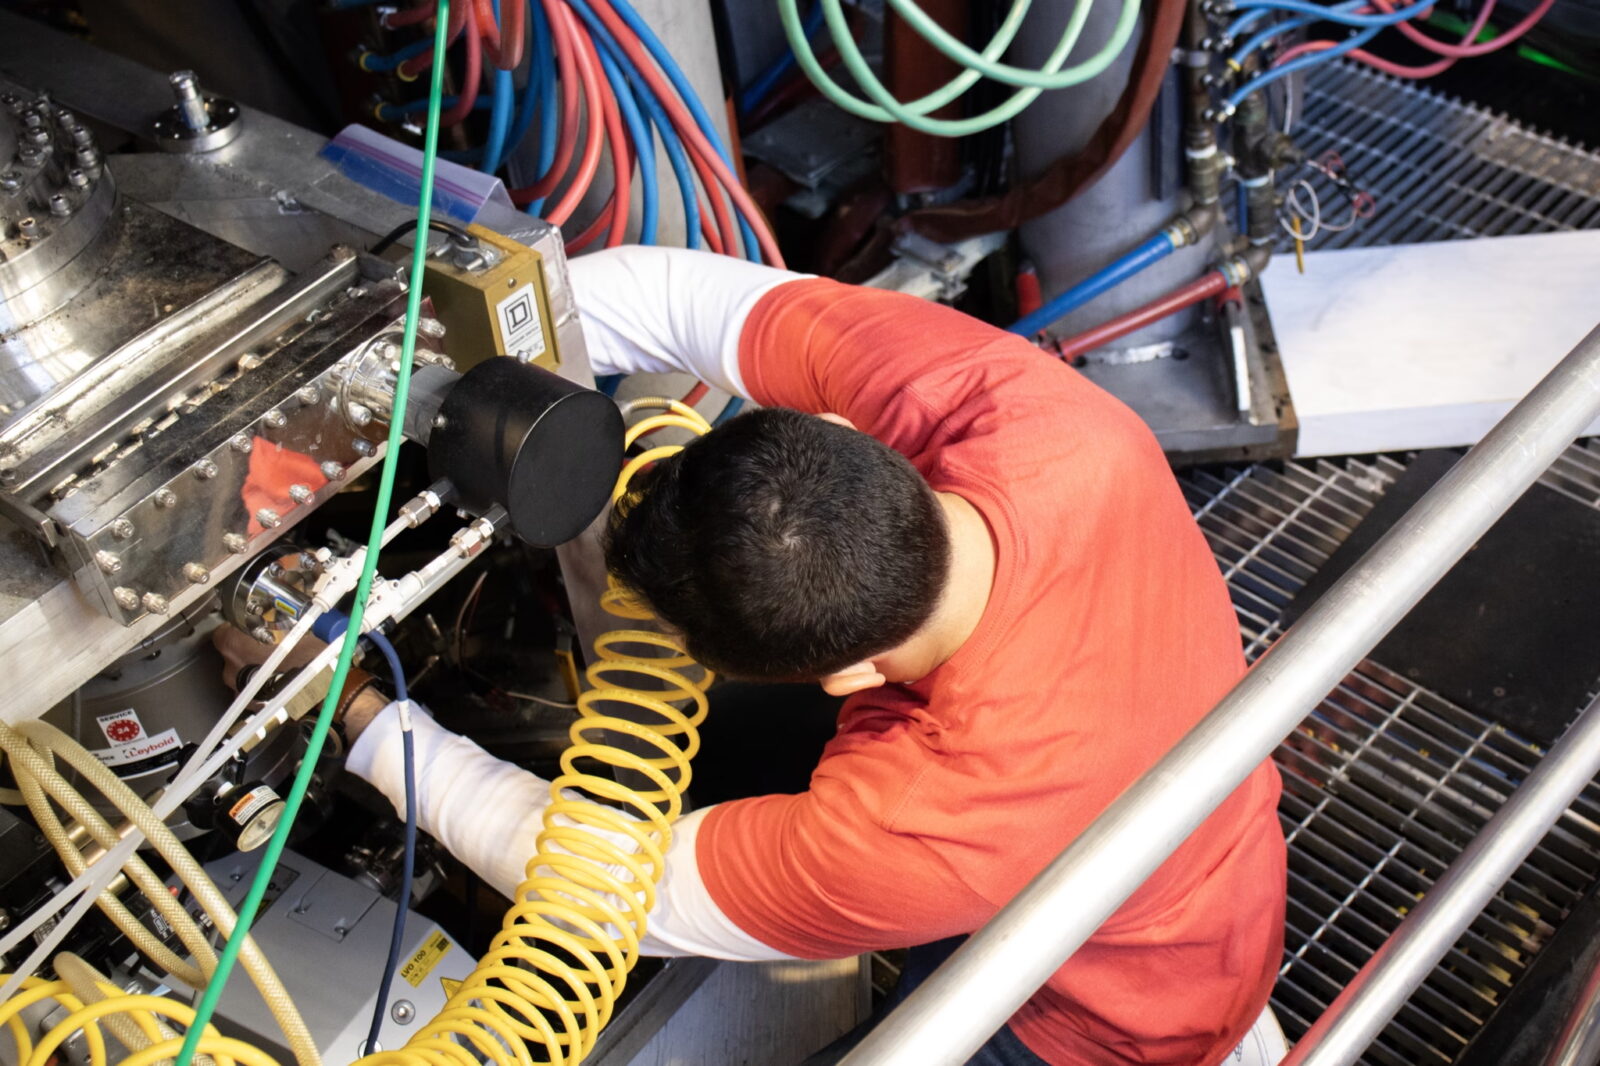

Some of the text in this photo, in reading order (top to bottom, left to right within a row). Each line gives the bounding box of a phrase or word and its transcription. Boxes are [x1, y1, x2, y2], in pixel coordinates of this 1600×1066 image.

[509, 301, 528, 328] D
[100, 710, 133, 722] SERVICE
[129, 736, 175, 757] Leybold
[401, 950, 426, 978] LVO 100
